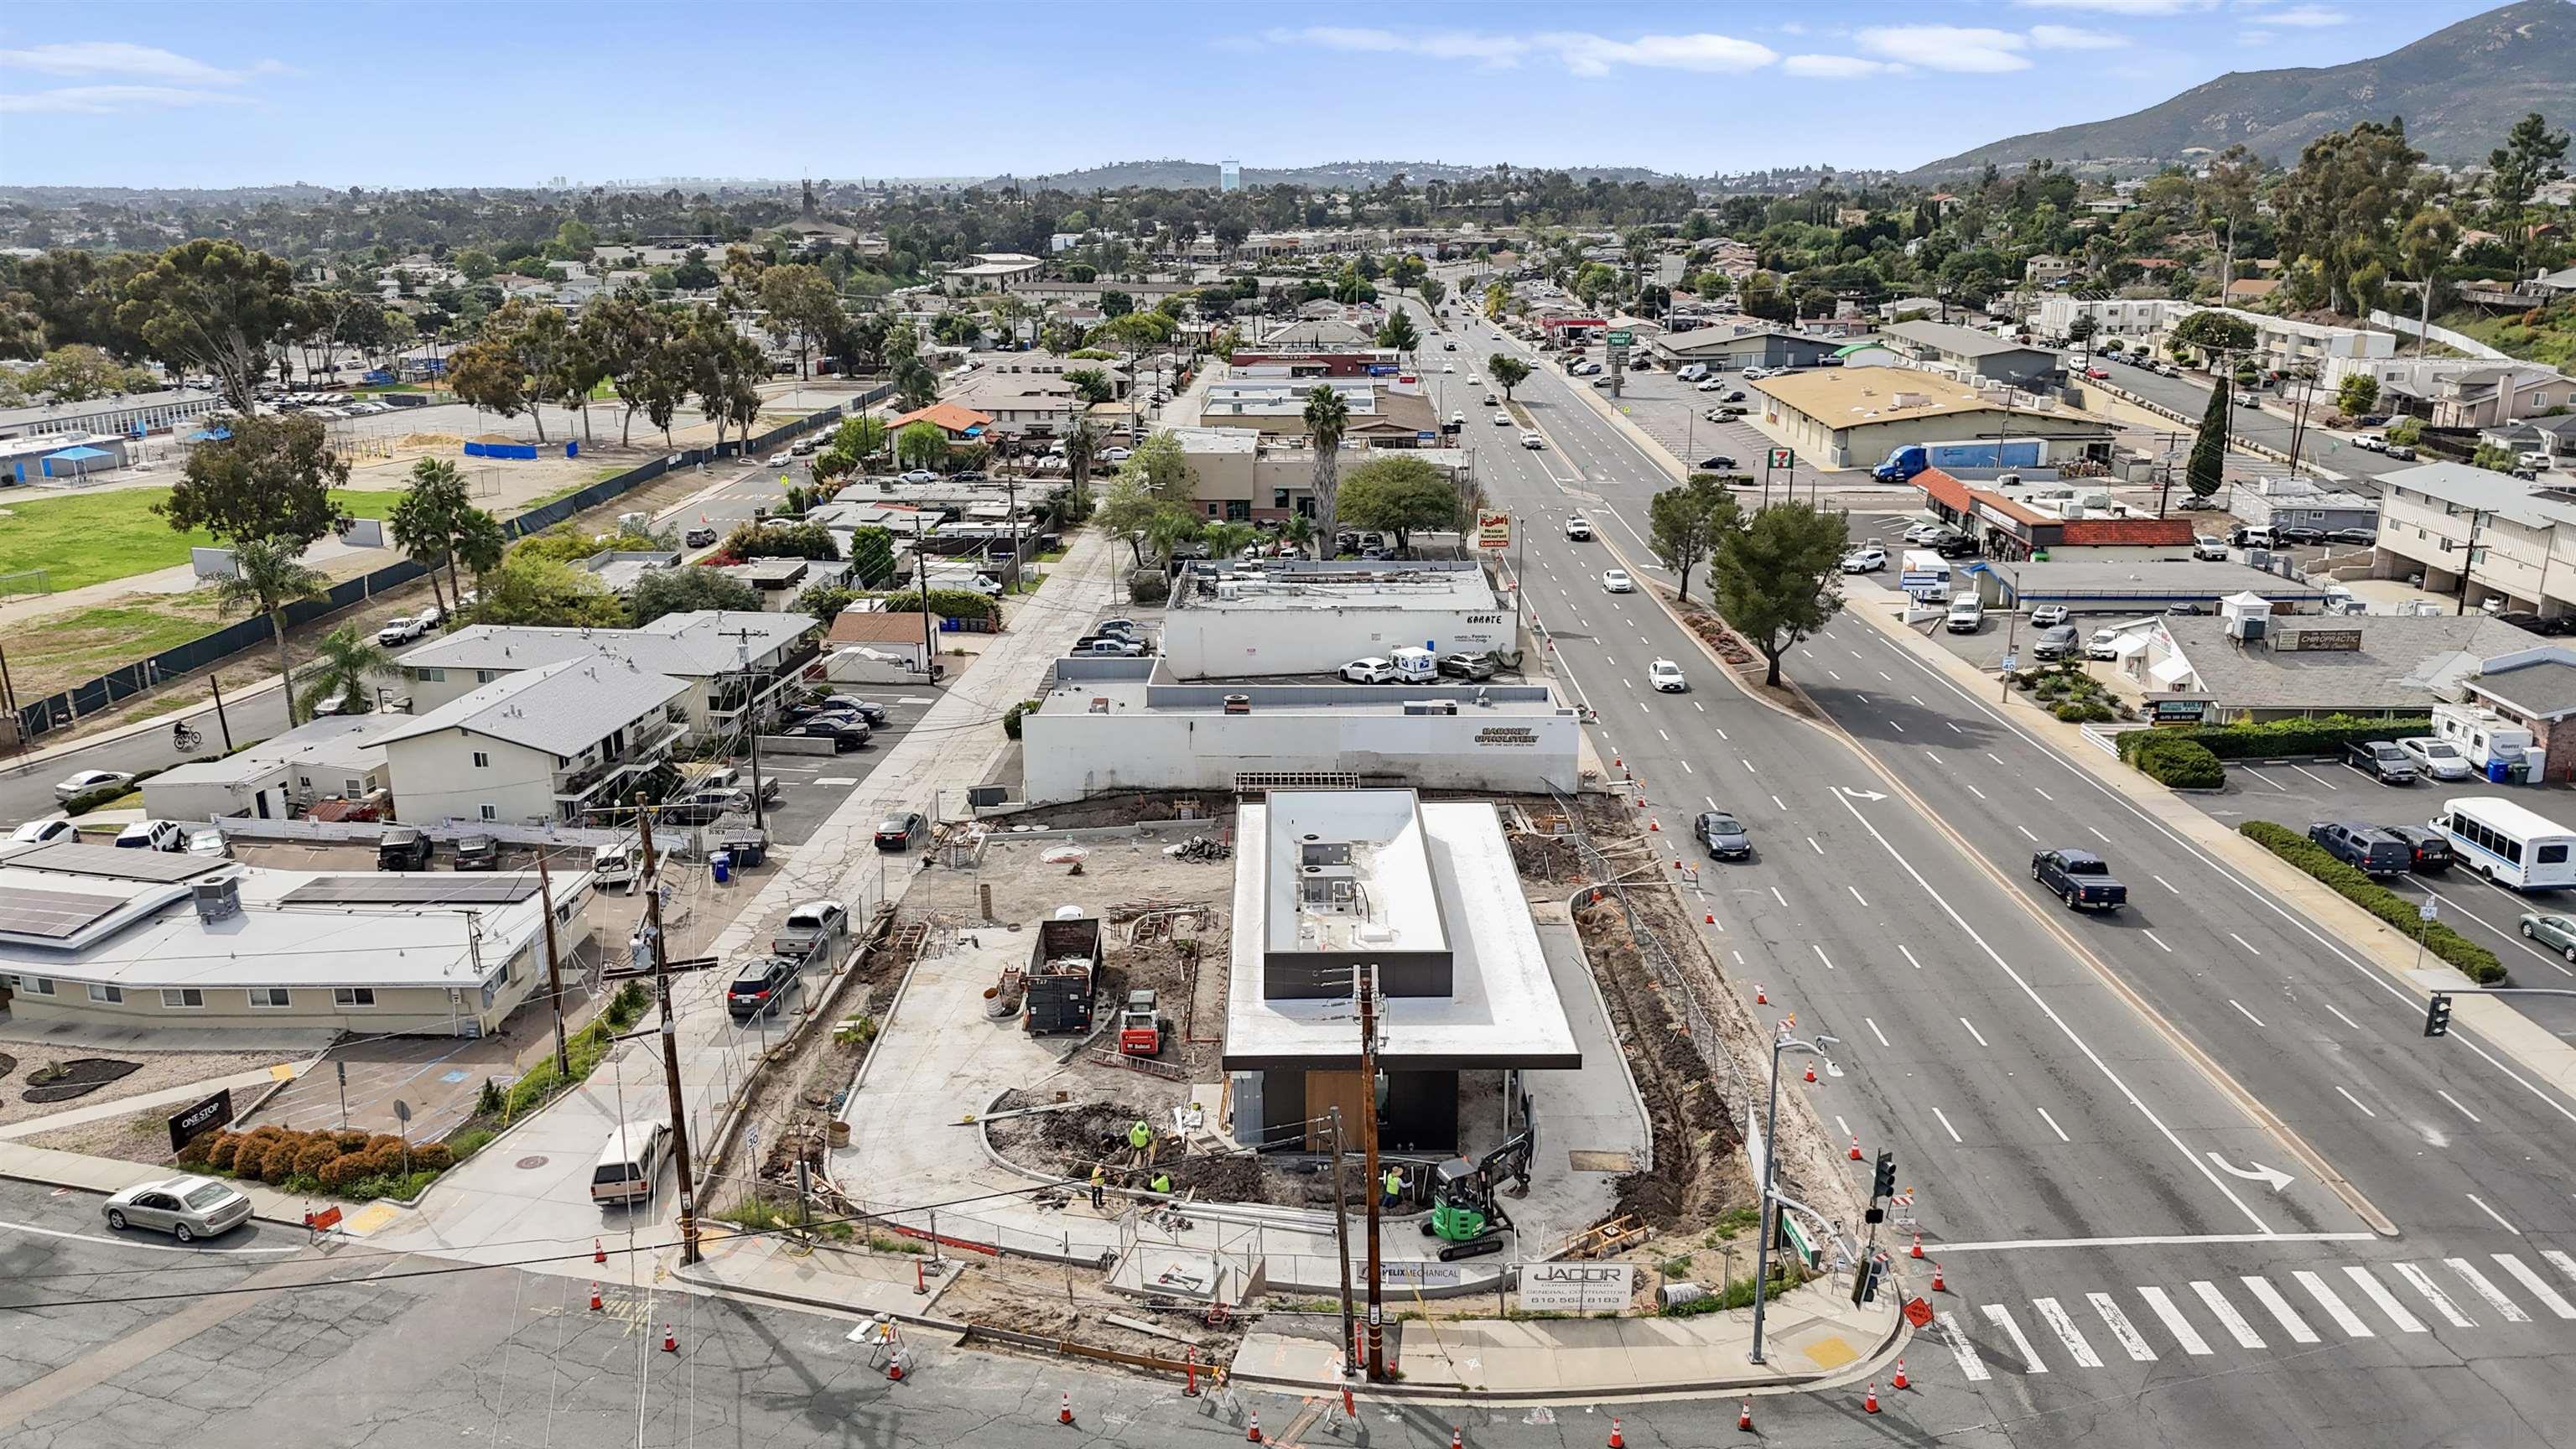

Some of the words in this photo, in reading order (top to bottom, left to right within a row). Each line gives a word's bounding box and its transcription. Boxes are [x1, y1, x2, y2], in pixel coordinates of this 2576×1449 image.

[1467, 615, 1502, 624] KARATE
[182, 1113, 200, 1128] ONE
[199, 1103, 219, 1120] STOP
[748, 1135, 759, 1148] 30
